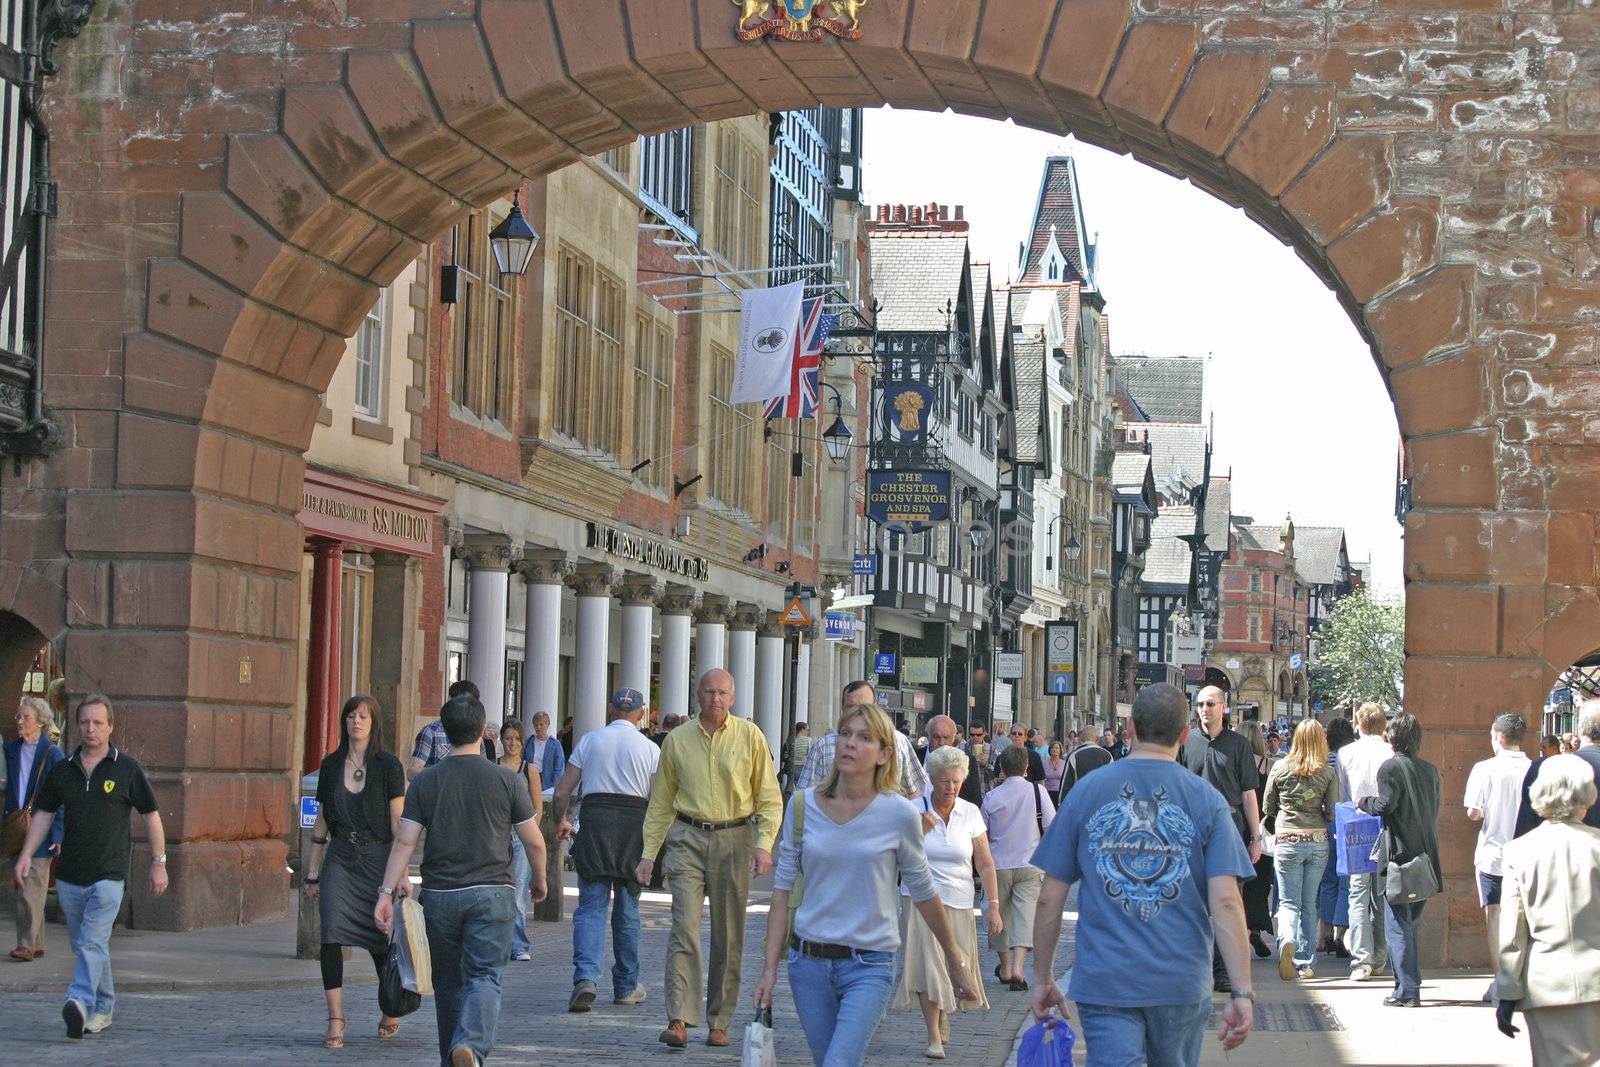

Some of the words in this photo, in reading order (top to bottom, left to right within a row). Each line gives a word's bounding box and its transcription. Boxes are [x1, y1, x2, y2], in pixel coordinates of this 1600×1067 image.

[896, 473, 923, 482] THE
[880, 483, 939, 493] CHESTER
[871, 493, 948, 504] GROSVENOR
[886, 504, 910, 512] AND
[912, 505, 931, 513] SPA
[328, 499, 369, 524] PAWNBROKER
[373, 505, 391, 536] S.S.
[391, 510, 429, 544] MILTON
[587, 521, 609, 553] THE
[611, 528, 644, 563] CHESTER
[645, 540, 685, 576] GROSVENOR
[686, 559, 698, 579] AND
[699, 557, 710, 582] SPA
[854, 558, 872, 569] citi
[1100, 837, 1143, 856] Hard
